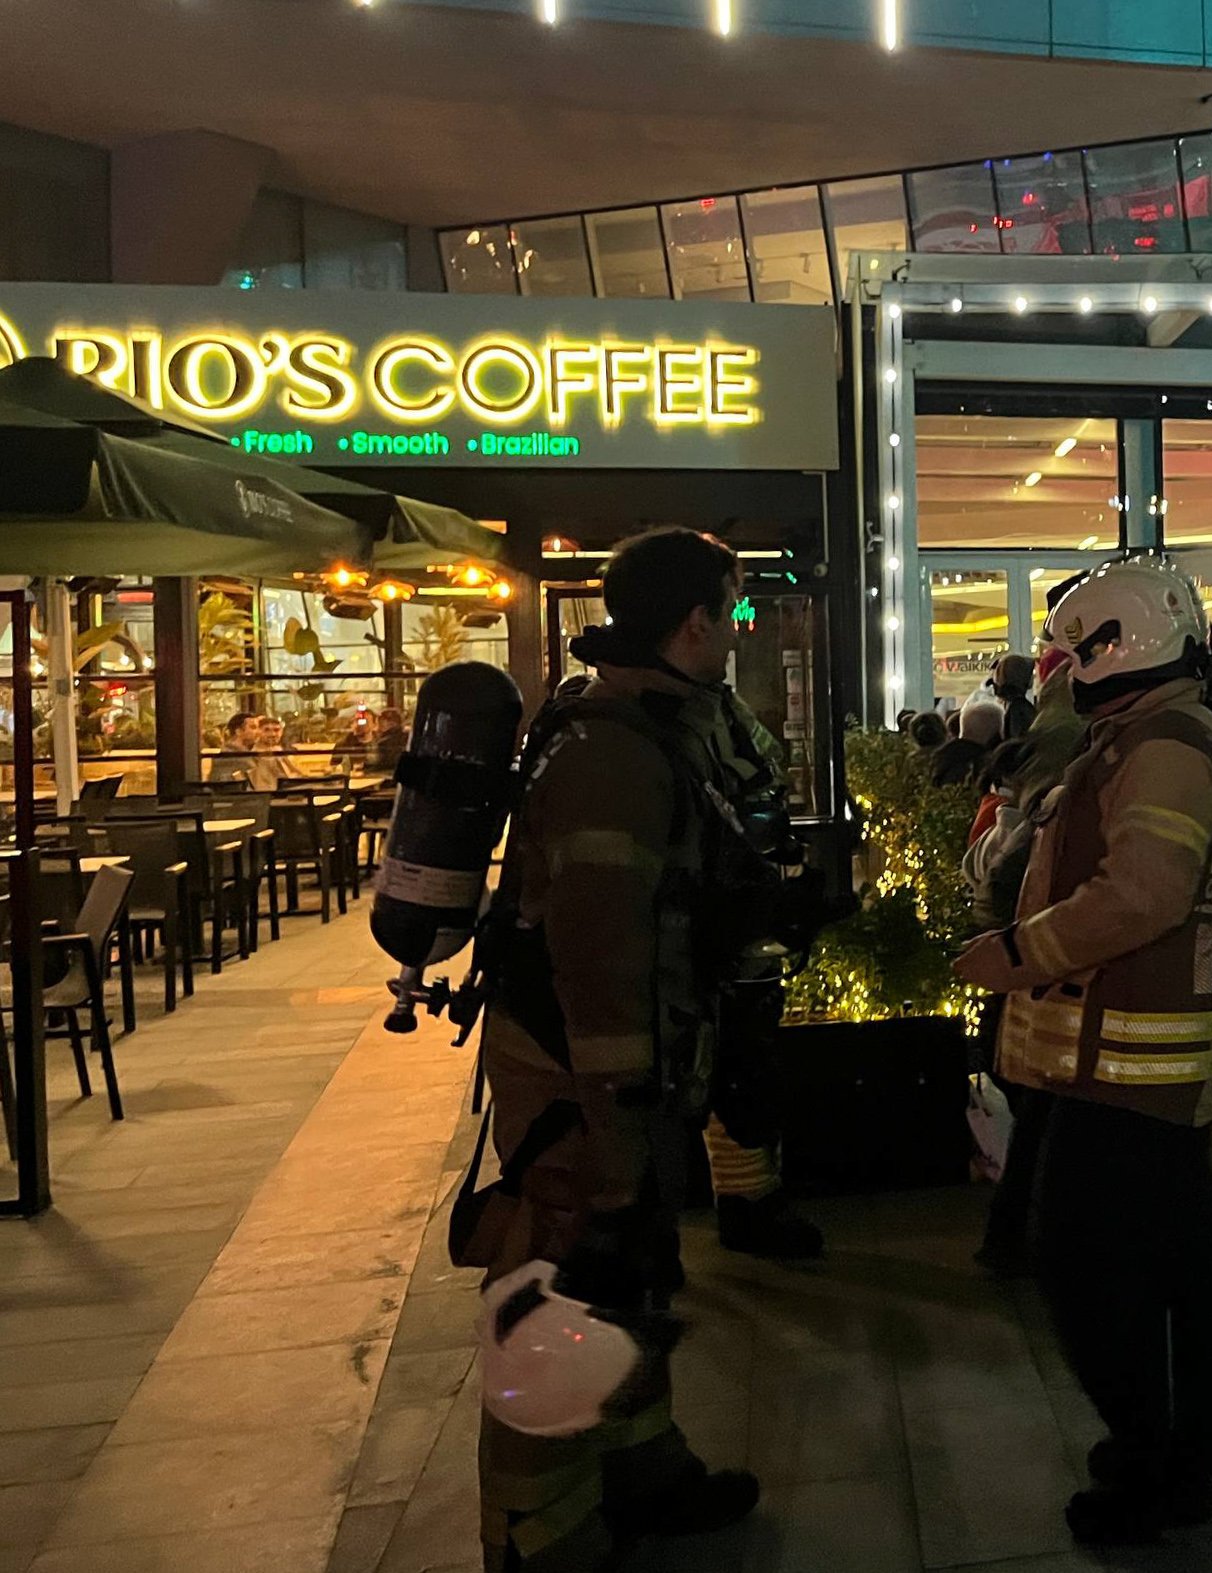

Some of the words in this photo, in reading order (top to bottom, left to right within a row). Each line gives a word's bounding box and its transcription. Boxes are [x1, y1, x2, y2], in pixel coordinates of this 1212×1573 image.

[370, 335, 760, 421] COFFEE
[243, 430, 313, 454] Fresh
[352, 431, 449, 455] Smooth
[481, 431, 579, 456] Brazilian
